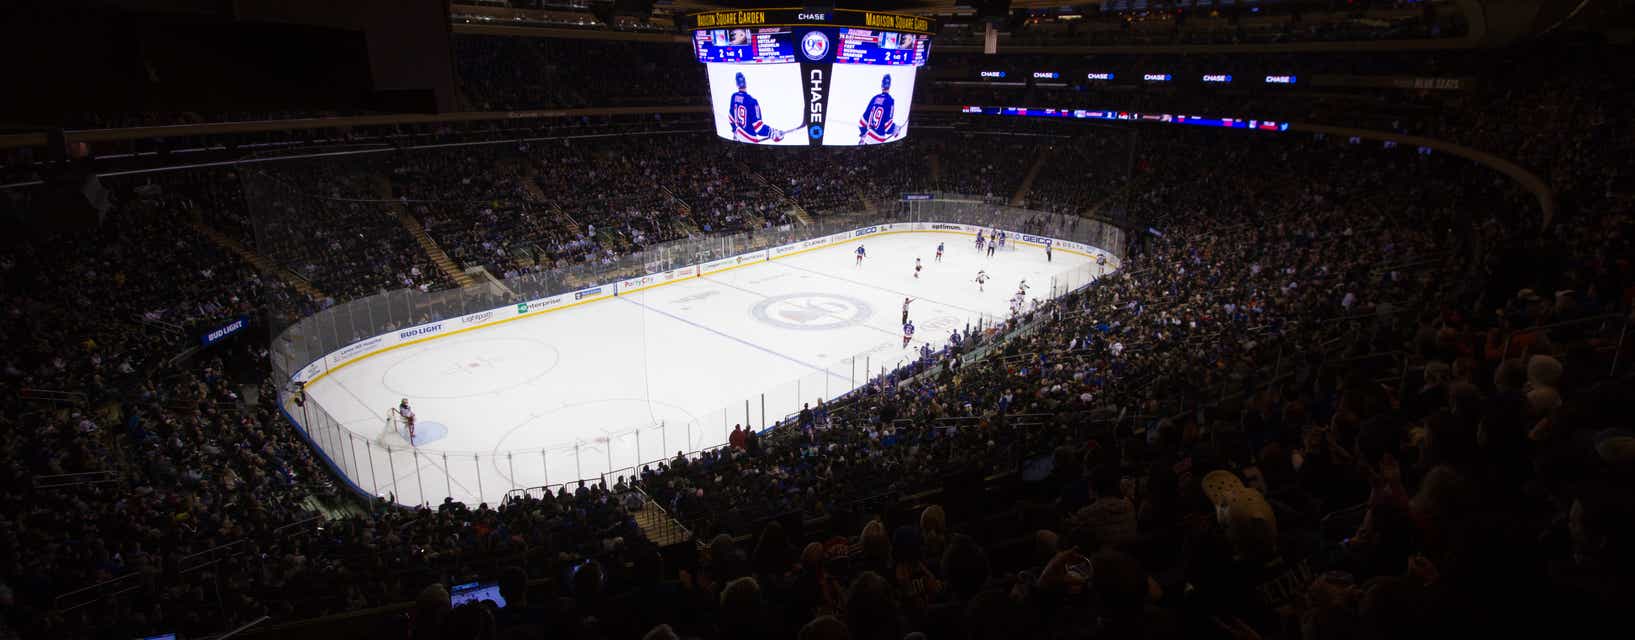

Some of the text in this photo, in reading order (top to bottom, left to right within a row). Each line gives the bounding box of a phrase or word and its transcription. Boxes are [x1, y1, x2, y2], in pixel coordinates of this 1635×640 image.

[716, 12, 738, 25] SQUARE
[738, 10, 765, 24] GARDEN
[798, 13, 825, 21] CHASE
[865, 12, 895, 27] MADISON
[719, 49, 724, 58] 2
[738, 49, 743, 57] 1
[885, 52, 891, 61] 2
[903, 53, 908, 61] 1
[810, 69, 823, 123] CHASE
[734, 104, 747, 129] 19
[868, 104, 884, 129] 19
[856, 227, 877, 236] GEICO
[1022, 235, 1053, 245] GEICO
[208, 320, 242, 342] BUD LIGHT
[400, 323, 442, 339] BUD LIGHT
